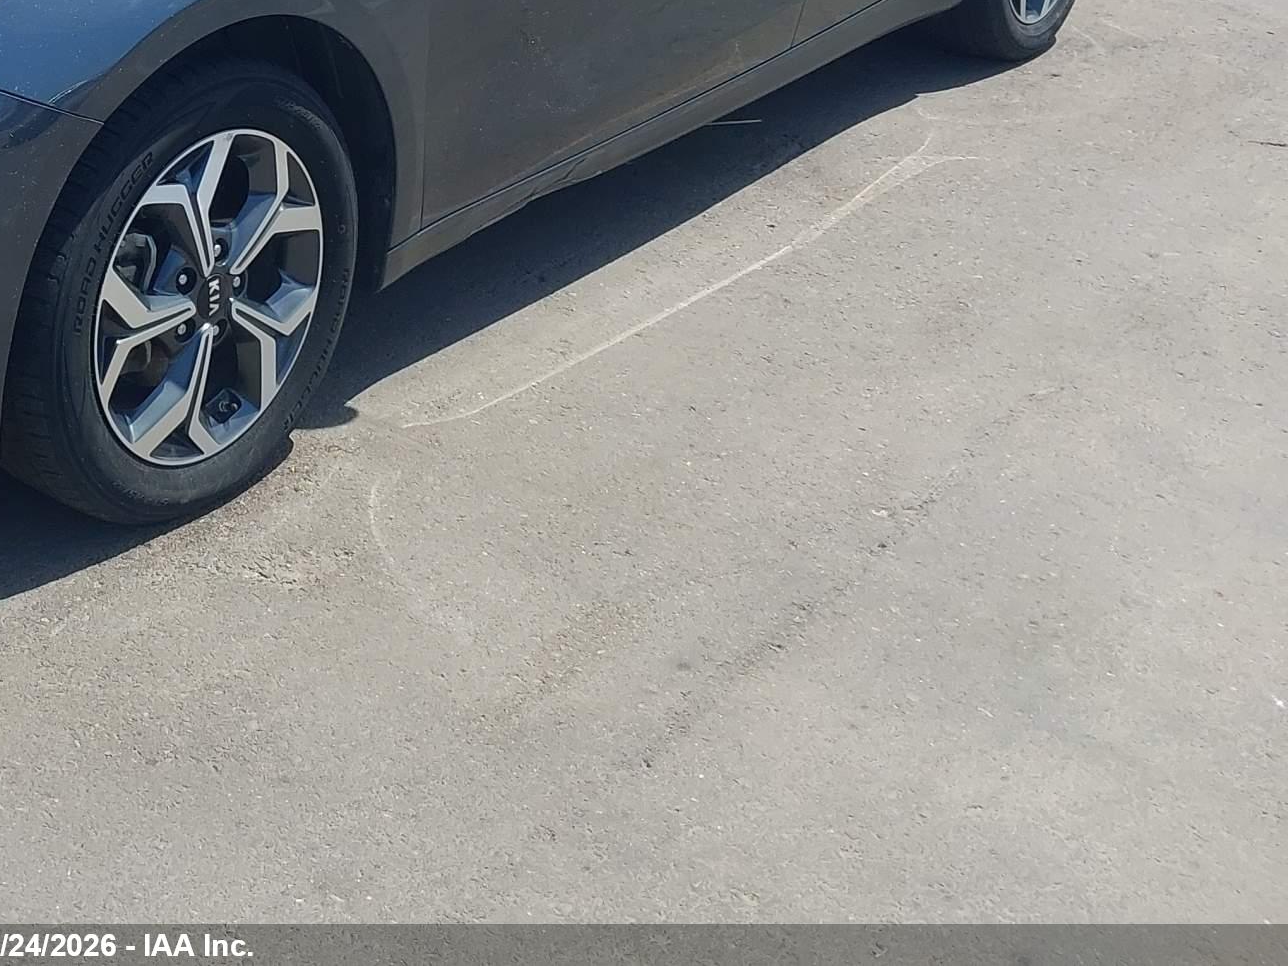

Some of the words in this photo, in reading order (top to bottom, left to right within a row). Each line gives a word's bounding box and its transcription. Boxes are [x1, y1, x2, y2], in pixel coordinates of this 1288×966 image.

[74, 256, 97, 333] ROAD
[94, 151, 154, 252] HUGGER
[209, 278, 220, 316] KIA
